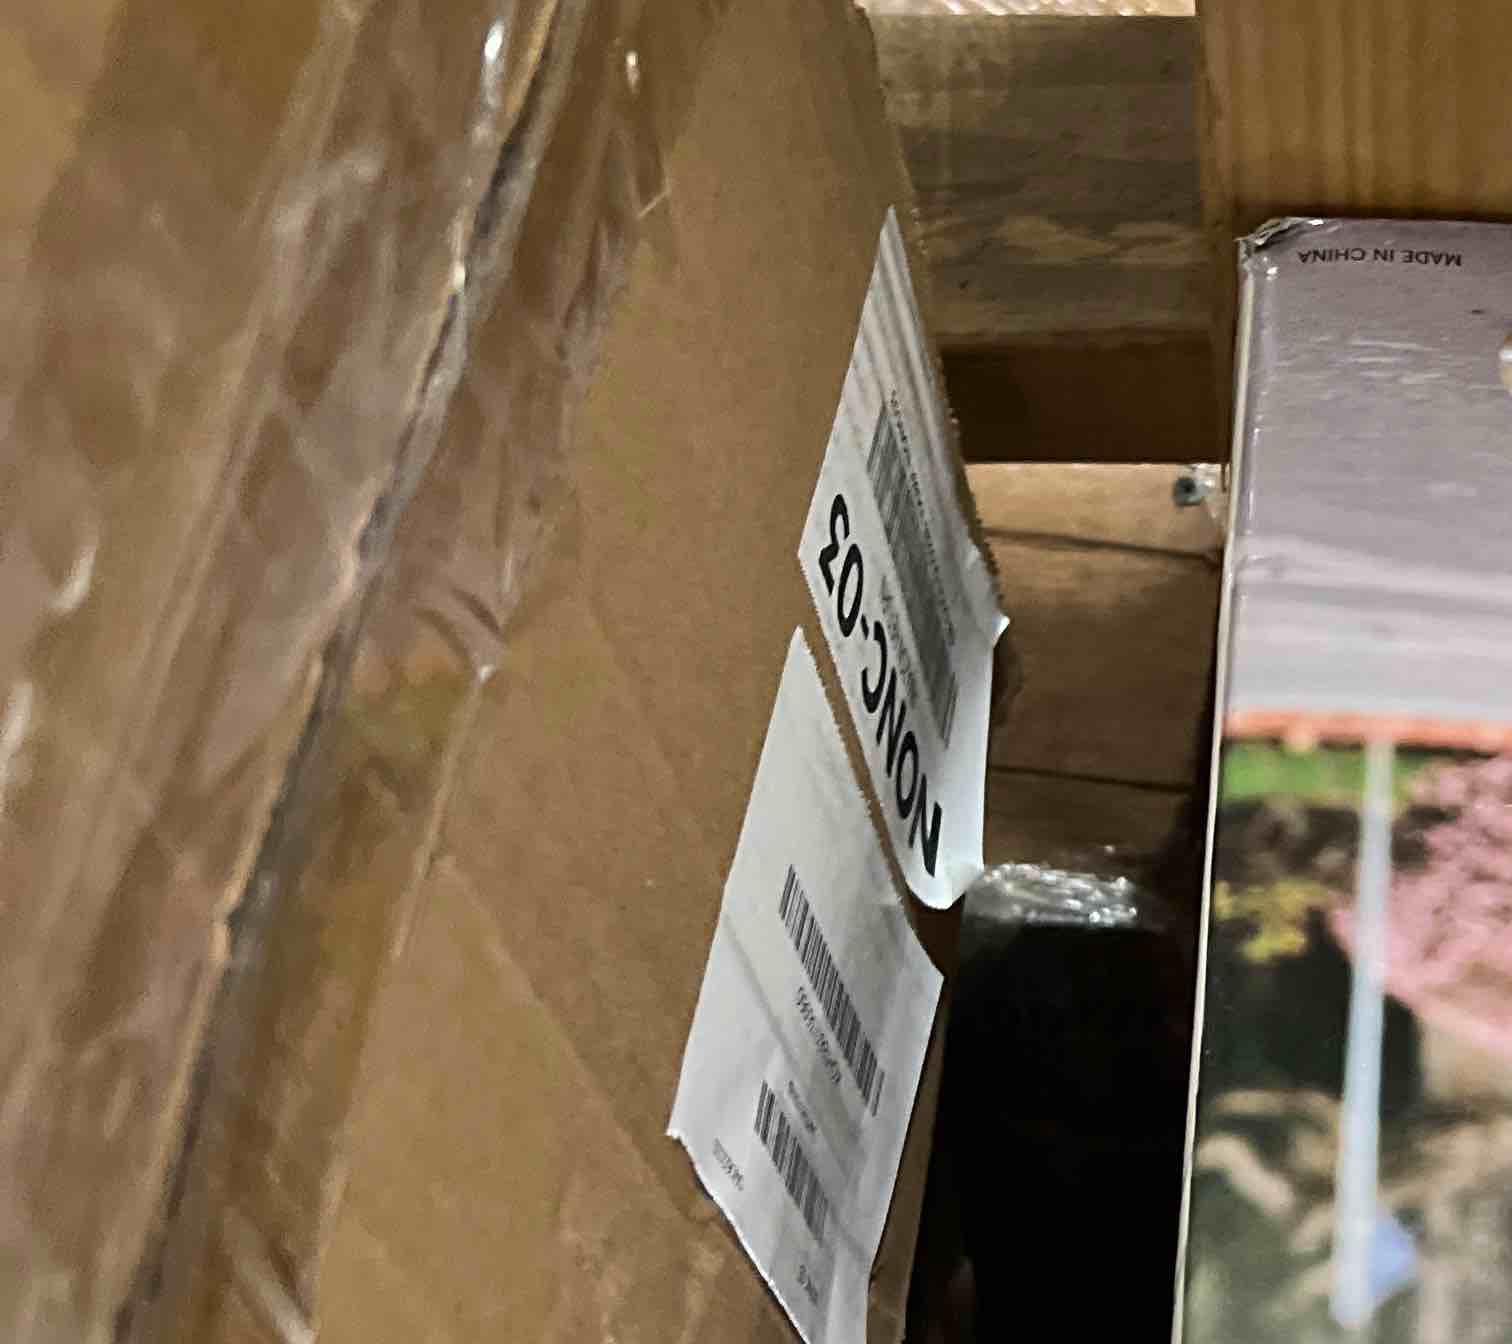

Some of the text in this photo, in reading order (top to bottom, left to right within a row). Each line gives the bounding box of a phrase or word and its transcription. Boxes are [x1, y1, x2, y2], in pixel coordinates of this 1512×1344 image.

[1298, 247, 1462, 267] MADE IN CHINA
[817, 493, 943, 878] NONC-03
